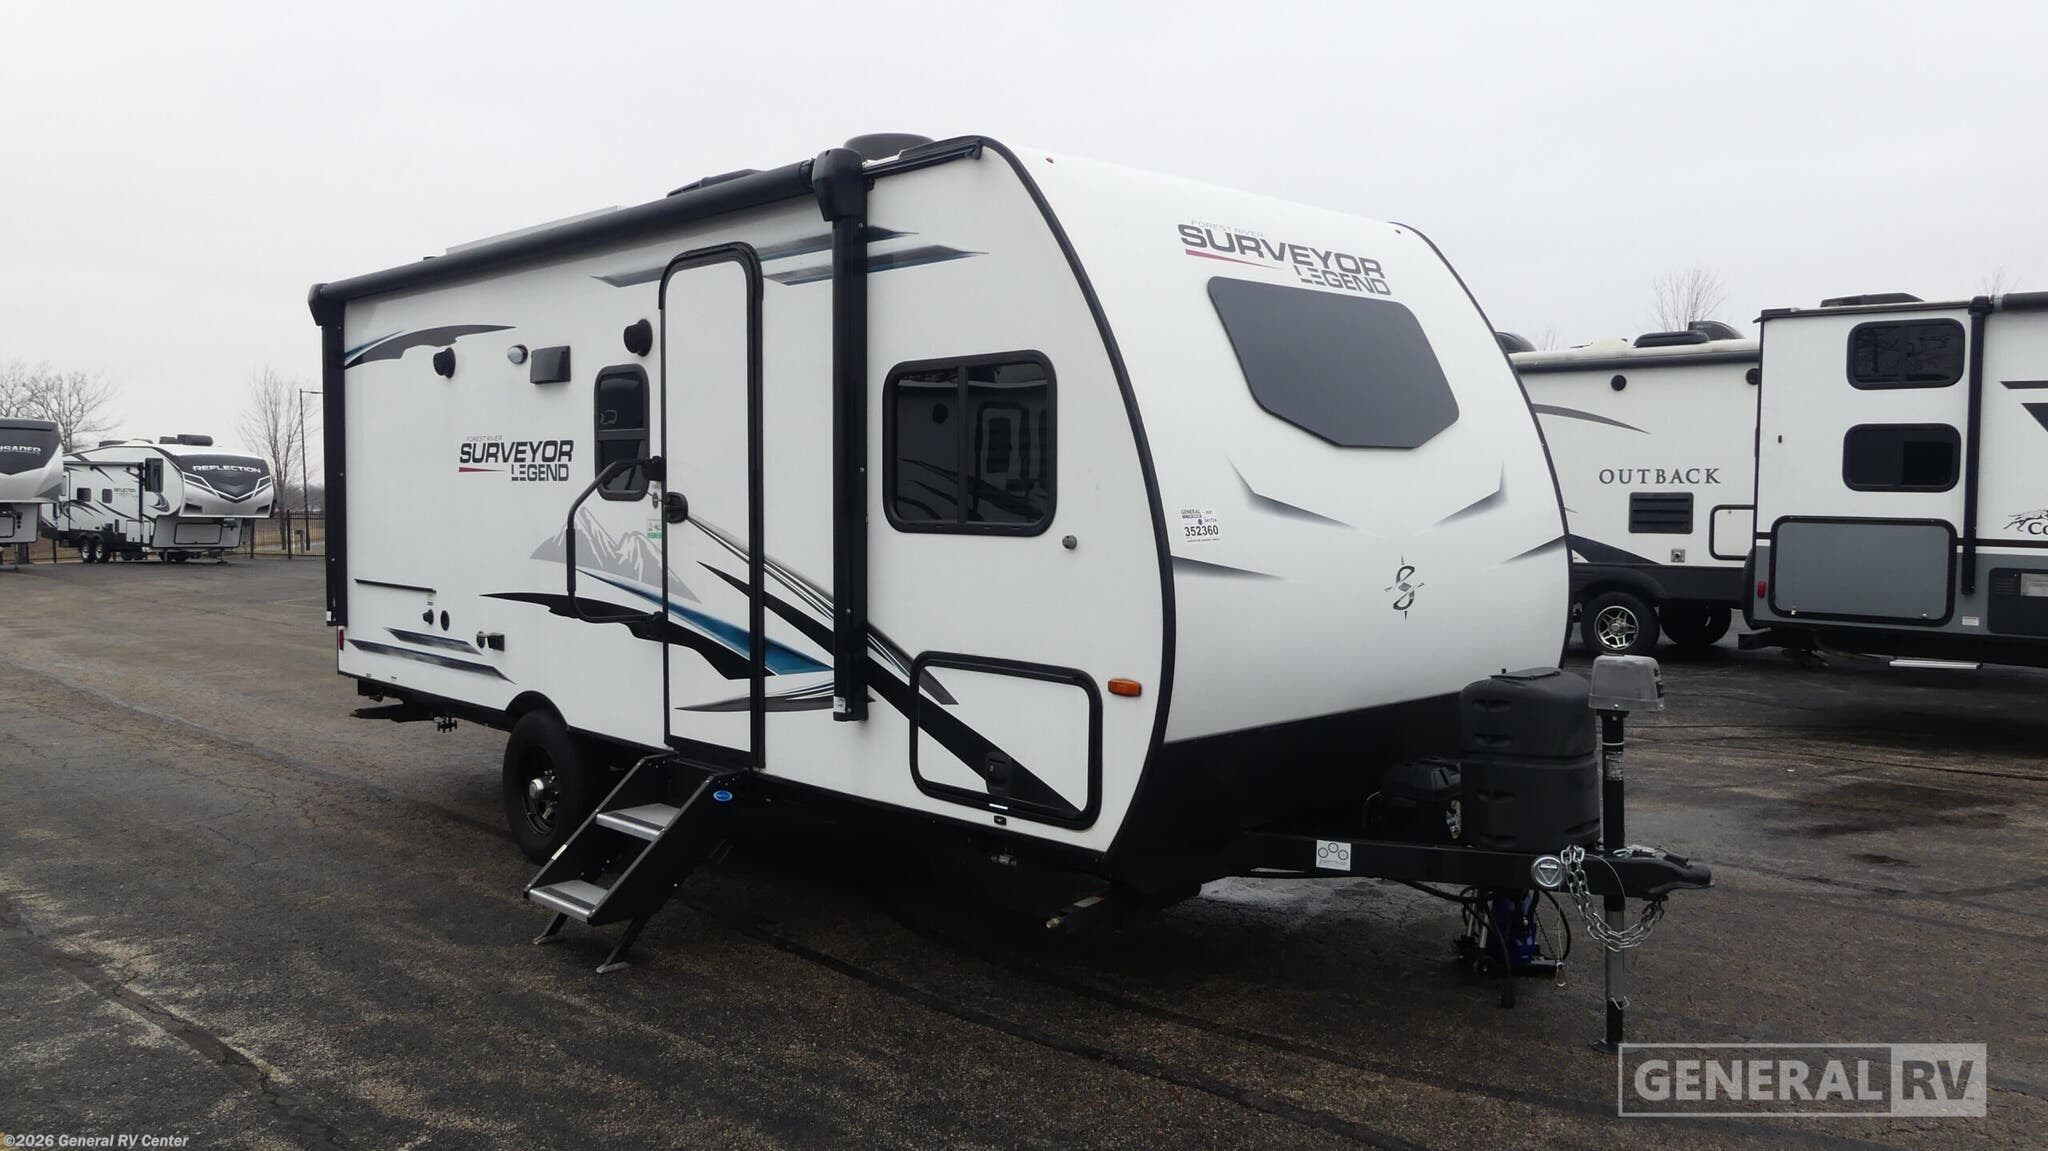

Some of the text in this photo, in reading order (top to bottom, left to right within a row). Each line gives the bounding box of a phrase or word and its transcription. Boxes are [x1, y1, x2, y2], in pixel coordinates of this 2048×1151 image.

[1191, 219, 1265, 238] FOREST RIVER
[1178, 223, 1386, 279] SURVEYOR
[1294, 264, 1391, 296] LEGEND
[460, 440, 574, 463] SURVEYOR
[192, 464, 261, 474] REFLECTION
[511, 463, 569, 481] LEGEND
[1599, 468, 1720, 484] OUTBACK
[1184, 525, 1219, 537] 352360
